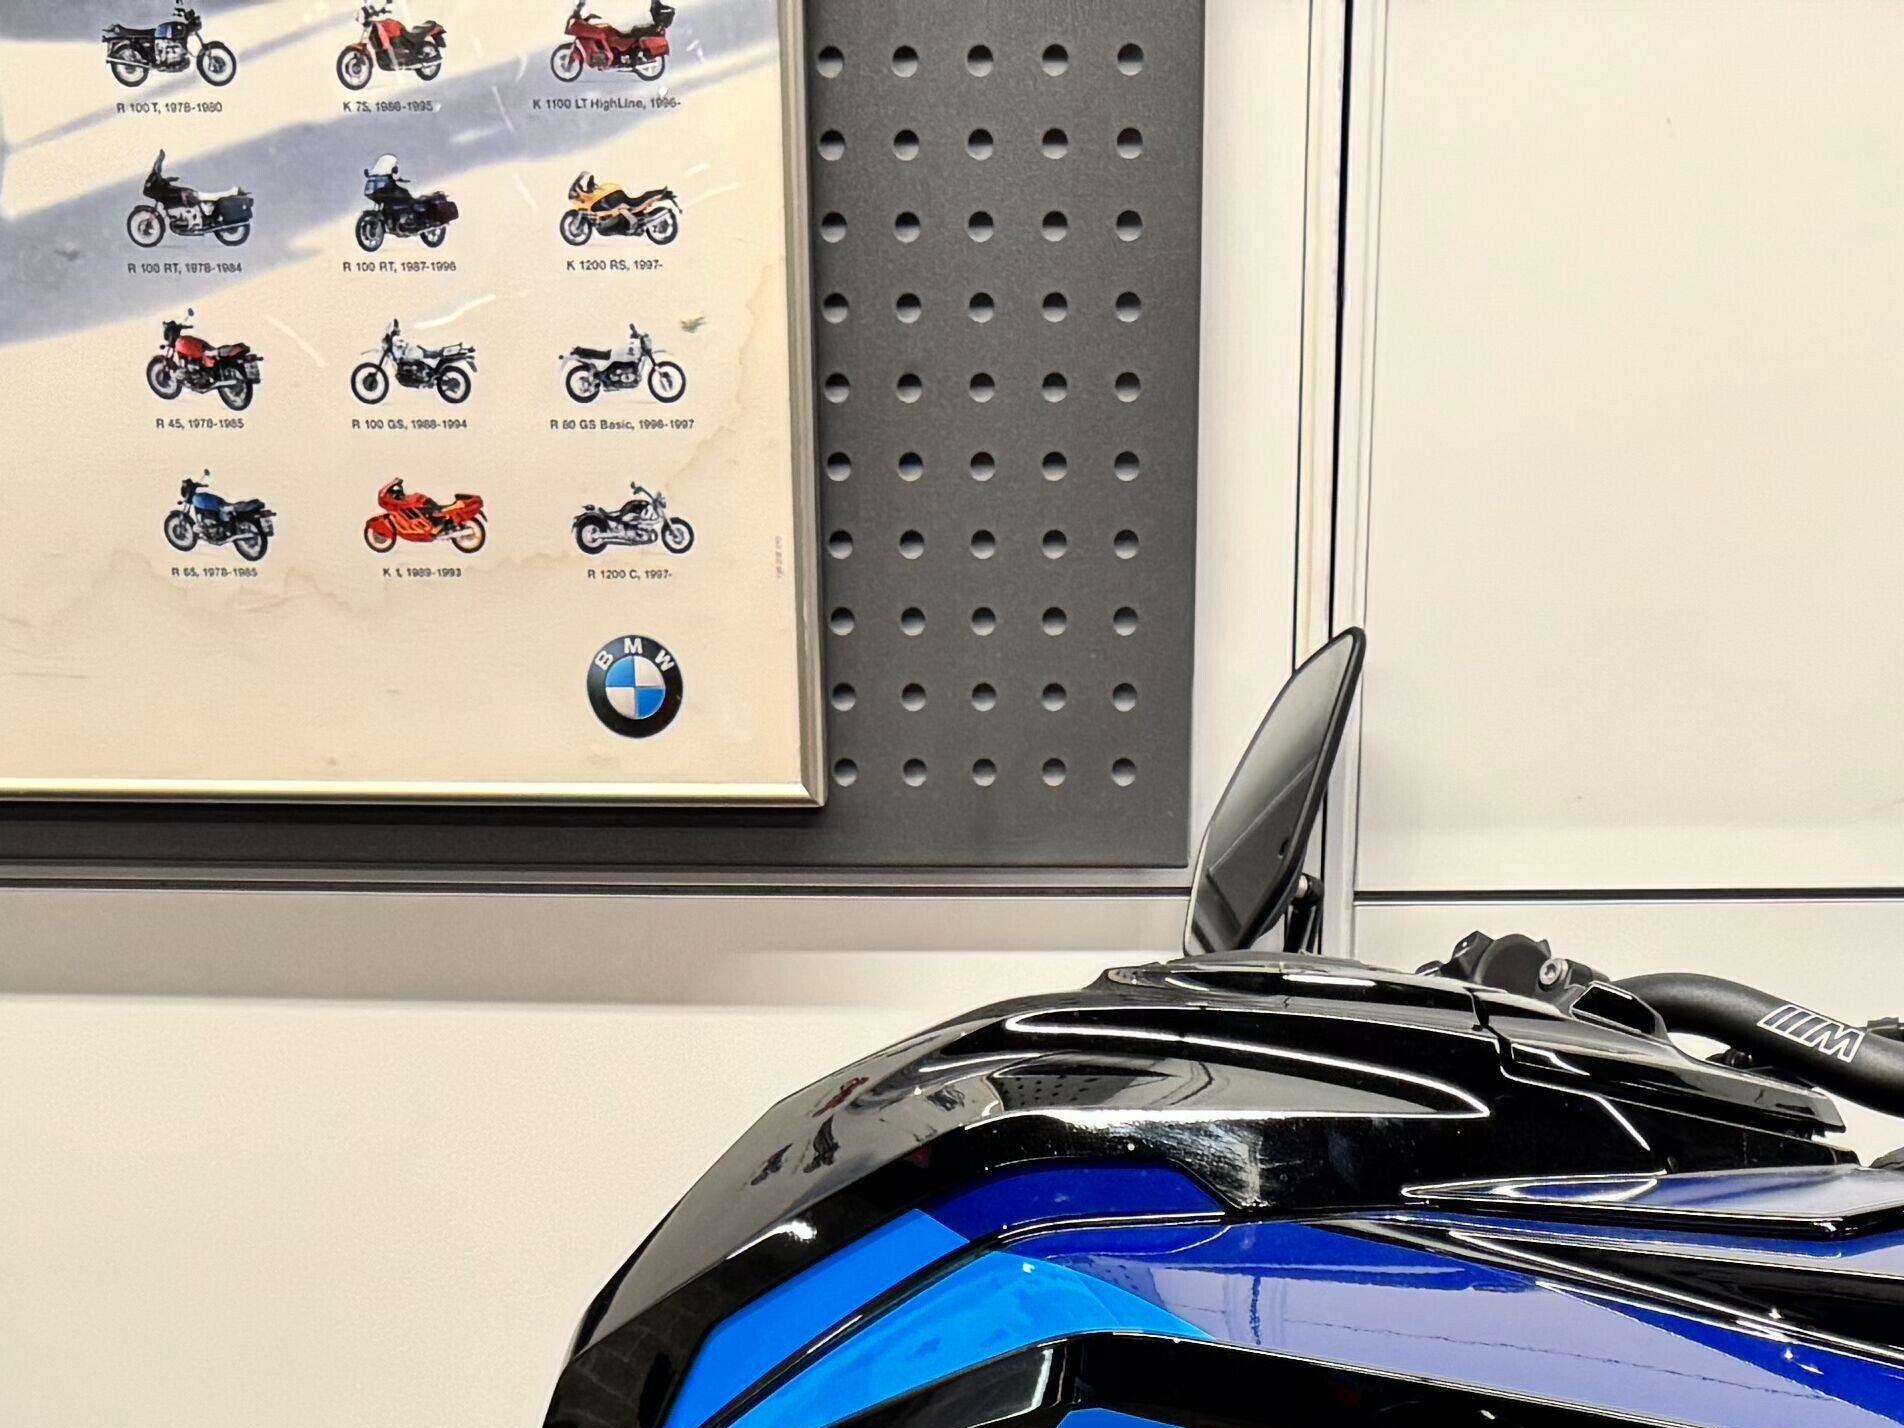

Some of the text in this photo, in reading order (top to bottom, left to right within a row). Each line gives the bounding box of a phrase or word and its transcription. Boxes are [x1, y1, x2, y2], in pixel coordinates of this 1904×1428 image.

[116, 101, 127, 114] R
[342, 100, 353, 113] K
[532, 98, 543, 111] K
[574, 98, 589, 111] LT
[127, 262, 137, 275] R
[342, 260, 352, 273] R
[566, 259, 576, 272] K
[155, 417, 166, 429] R
[351, 418, 361, 430] R
[549, 418, 560, 430] R
[578, 418, 597, 431] GS
[170, 566, 181, 577] R
[382, 567, 392, 578] K
[587, 568, 597, 580] R
[628, 568, 641, 581] C,
[595, 637, 675, 671] BMW
